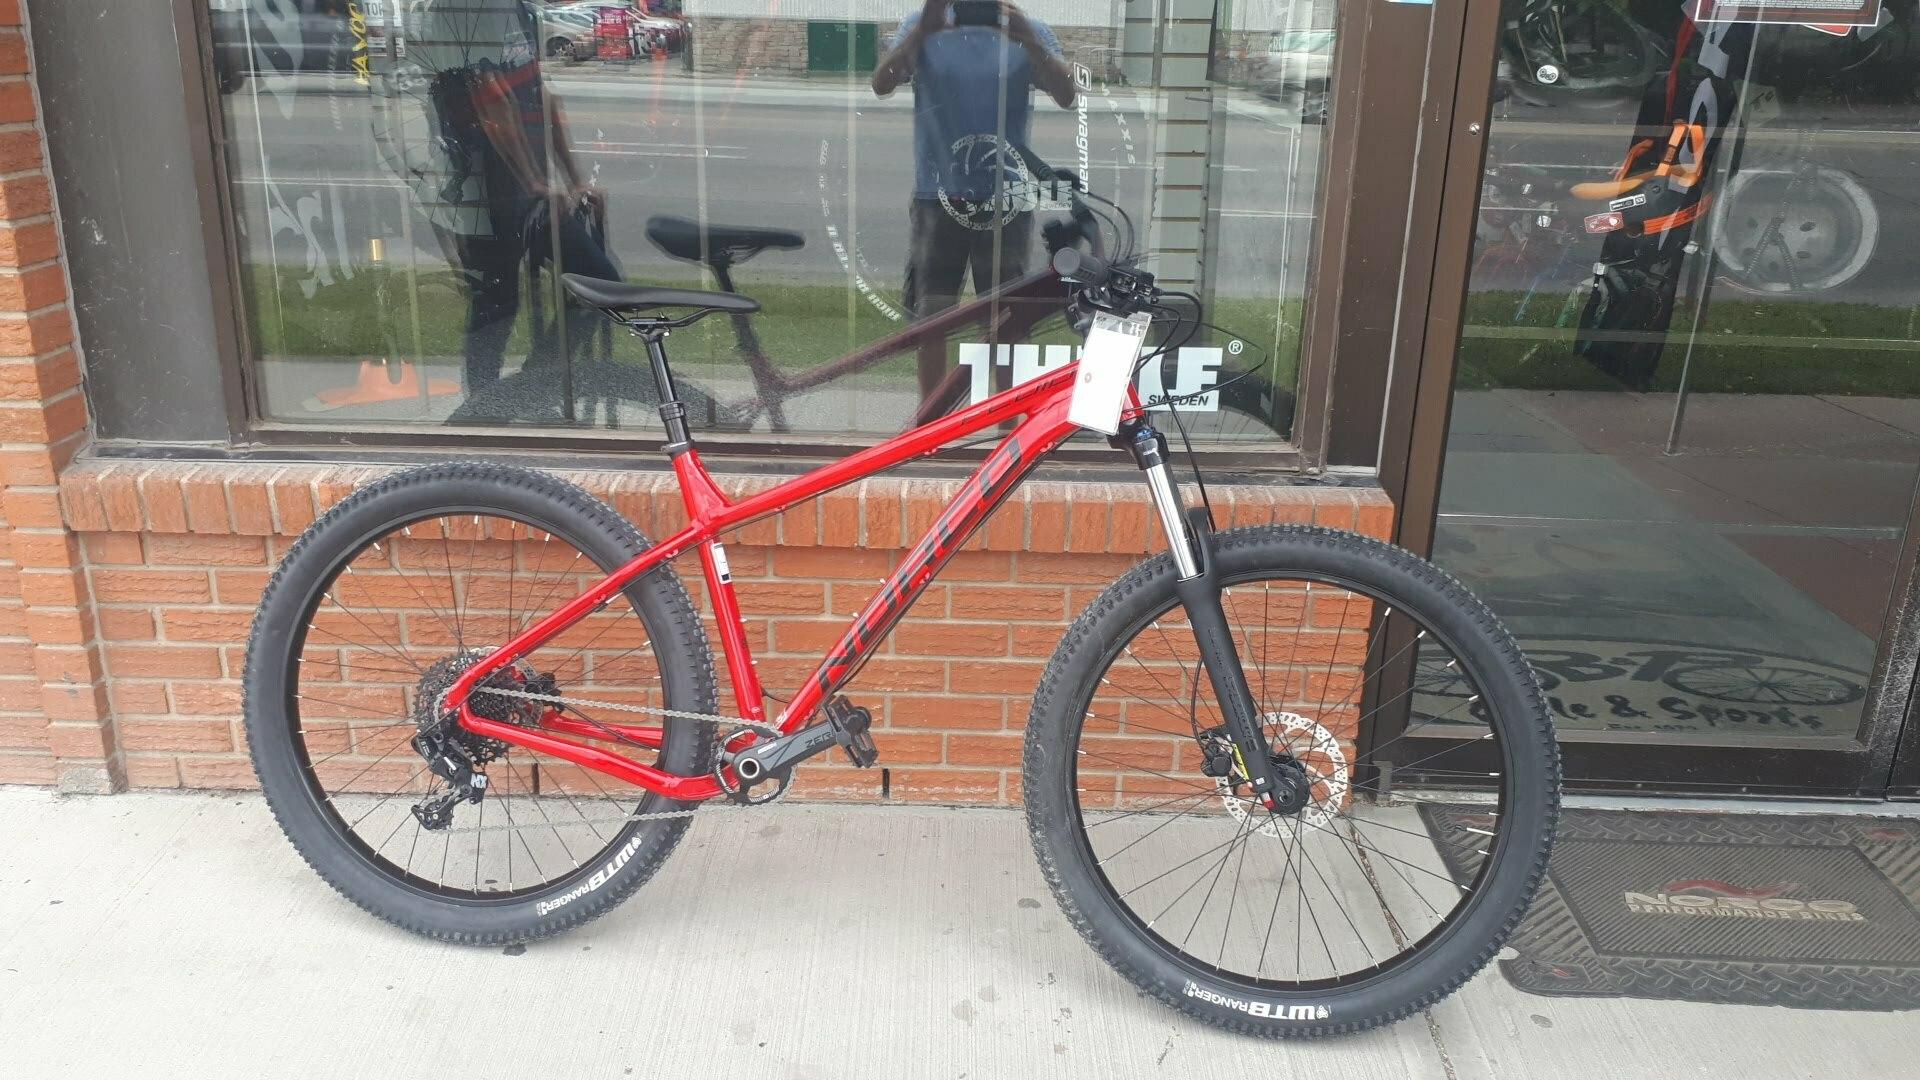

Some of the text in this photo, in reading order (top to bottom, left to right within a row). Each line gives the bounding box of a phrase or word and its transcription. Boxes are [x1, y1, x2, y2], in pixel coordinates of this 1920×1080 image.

[959, 342, 1223, 412] THLE
[1148, 393, 1209, 407] SWEDEN
[588, 842, 636, 892] WTB
[546, 884, 591, 911] RANGER
[1624, 891, 1857, 914] NORCO
[1194, 985, 1249, 1013] RANGER
[1248, 1001, 1316, 1021] WTB
